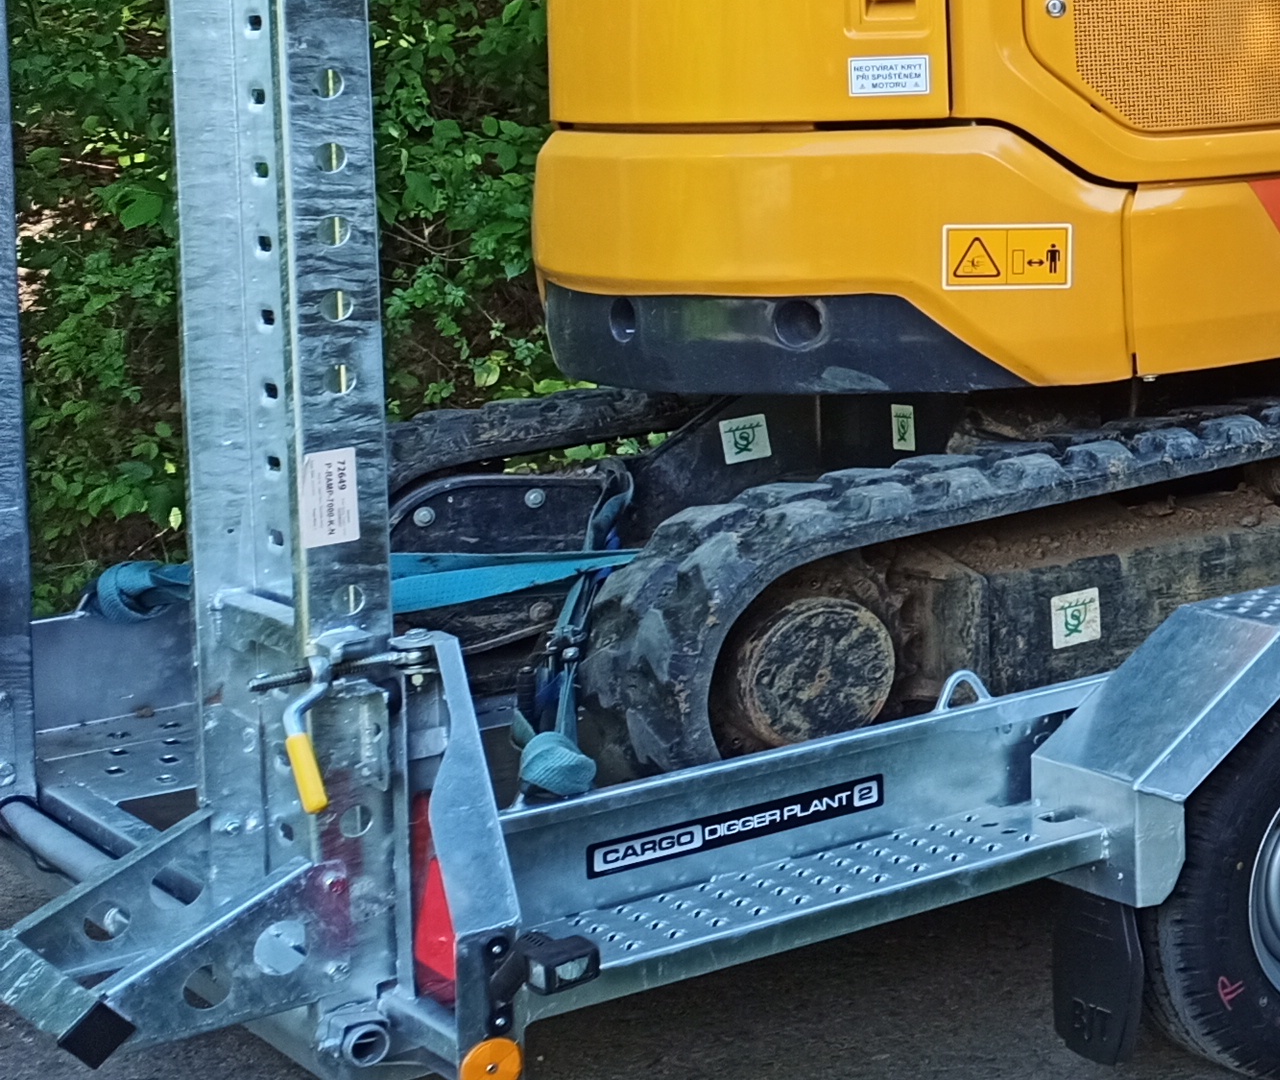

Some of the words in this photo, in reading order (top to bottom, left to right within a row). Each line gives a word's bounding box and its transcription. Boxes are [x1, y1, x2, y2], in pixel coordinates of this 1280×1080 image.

[871, 81, 907, 89] MOTORU
[337, 460, 347, 491] 72649
[602, 830, 695, 865] CARGO
[704, 809, 781, 841] DIGGER
[783, 791, 852, 821] PLANT
[857, 785, 874, 801] 2
